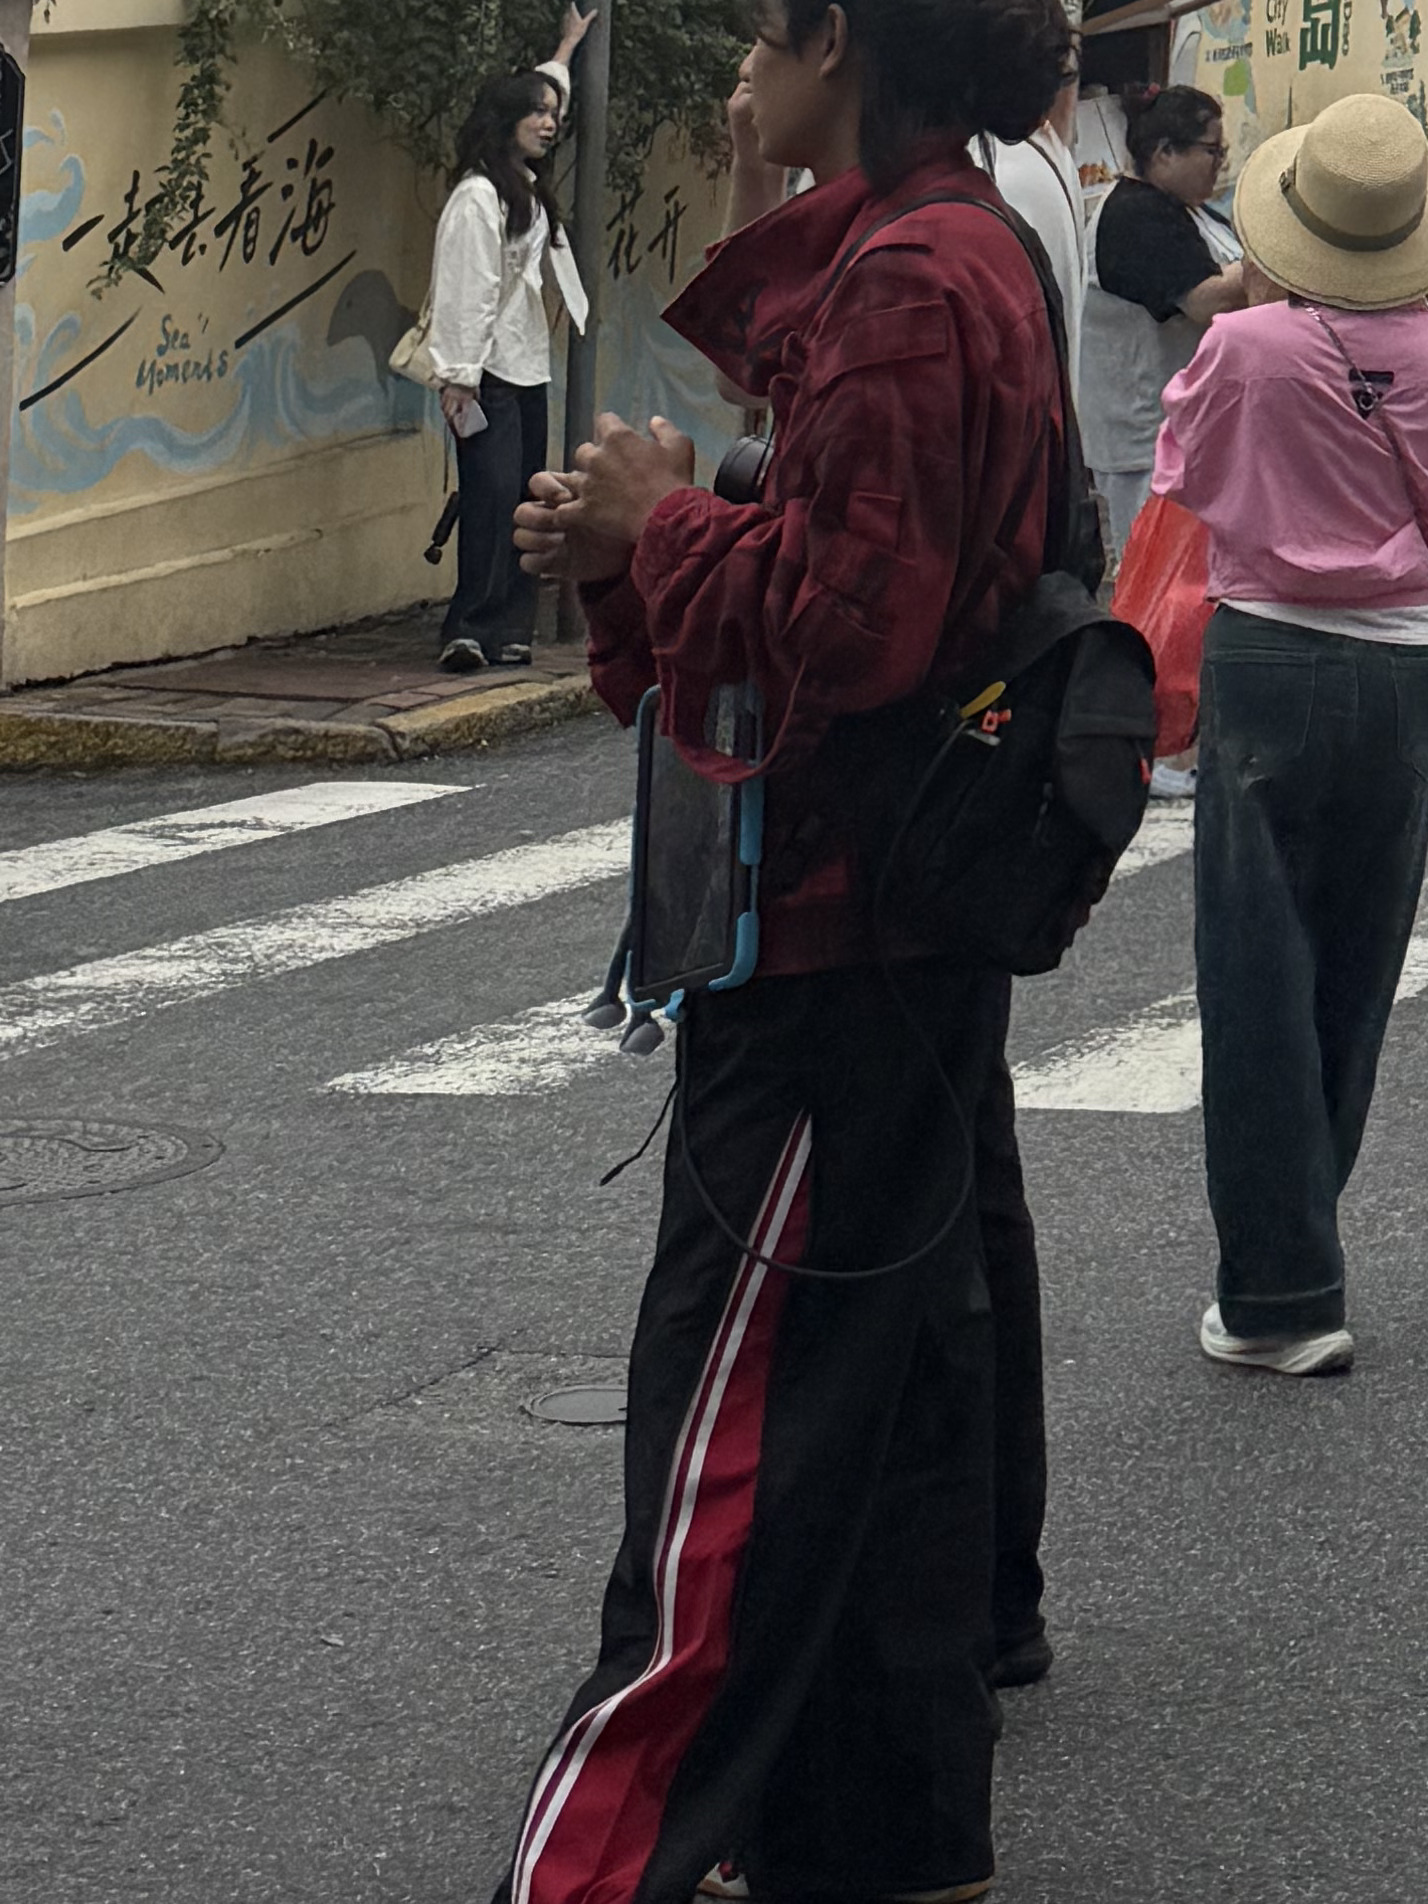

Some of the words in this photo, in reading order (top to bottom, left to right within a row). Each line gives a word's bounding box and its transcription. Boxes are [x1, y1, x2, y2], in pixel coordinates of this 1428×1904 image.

[1265, 28, 1291, 58] Walk
[606, 184, 688, 285] 花开
[156, 313, 192, 357] Sea
